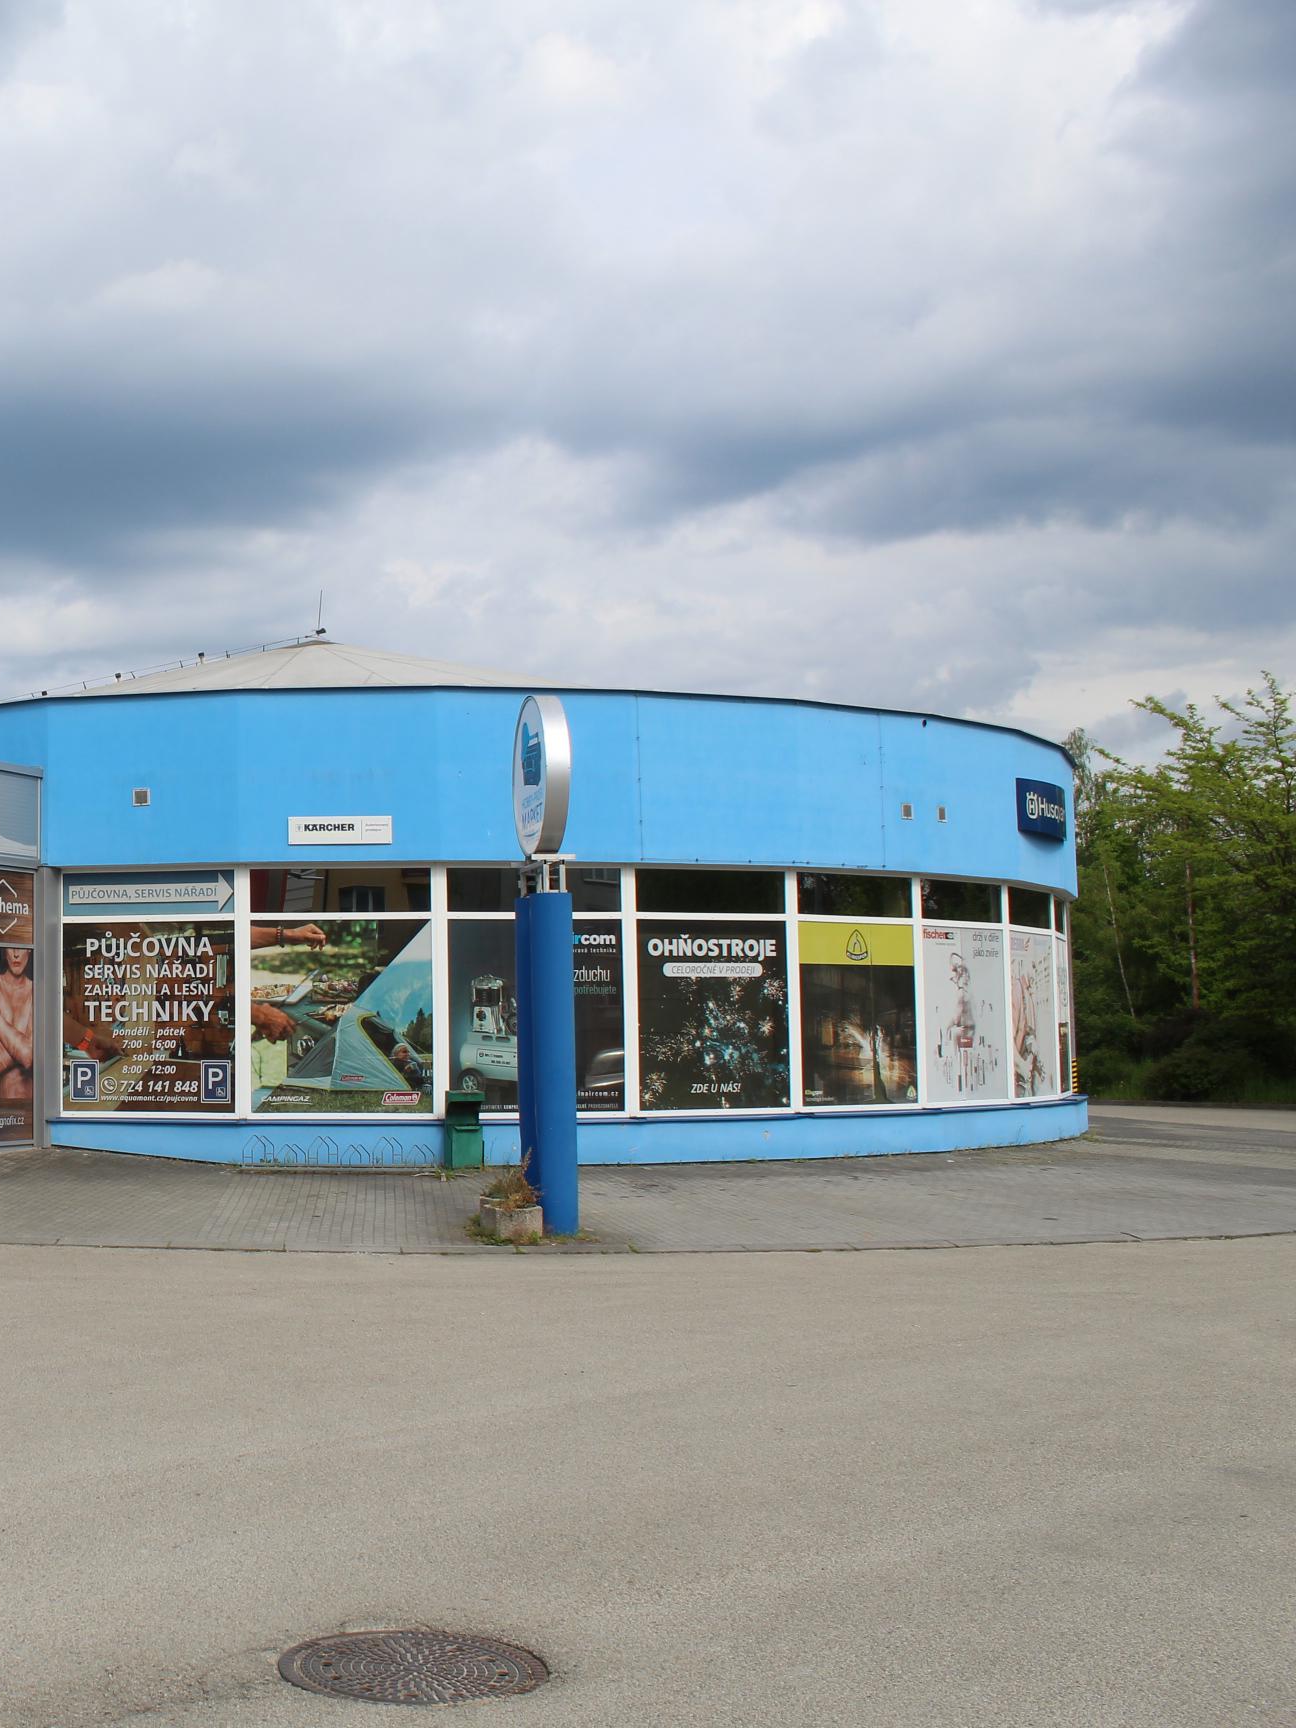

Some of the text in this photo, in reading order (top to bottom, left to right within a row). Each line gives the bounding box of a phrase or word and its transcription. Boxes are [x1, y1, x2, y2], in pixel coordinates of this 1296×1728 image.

[303, 823, 355, 832] KÄRCHER
[71, 885, 218, 900] PŮJČOVNA, SERVIS NÁŘADÍ
[923, 928, 947, 940] fischer
[85, 931, 214, 962] PŮJČOVNA
[647, 934, 777, 961] OHŇOSTROJE
[84, 960, 216, 979] SERVIS NÁŘADÍ
[573, 965, 610, 982] zduchu
[84, 981, 158, 996] ZAHRADNÍ
[160, 984, 171, 996] A
[84, 1001, 215, 1022] TECHNIKY
[112, 1027, 149, 1038] pondělí
[156, 1026, 186, 1038] pátek
[122, 1039, 142, 1049] 7:00
[151, 1039, 177, 1049] 16:00
[131, 1052, 166, 1062] sobota
[122, 1065, 142, 1074] 8:00
[151, 1065, 177, 1074] 12:00
[77, 1067, 92, 1089] P
[208, 1068, 224, 1090] P
[119, 1080, 199, 1093] 724 141 848
[690, 1081, 742, 1094] ZDE U NÁS!
[100, 1094, 198, 1104] www.aquamont.cz/pujcovna
[385, 1093, 412, 1102] Coleman
